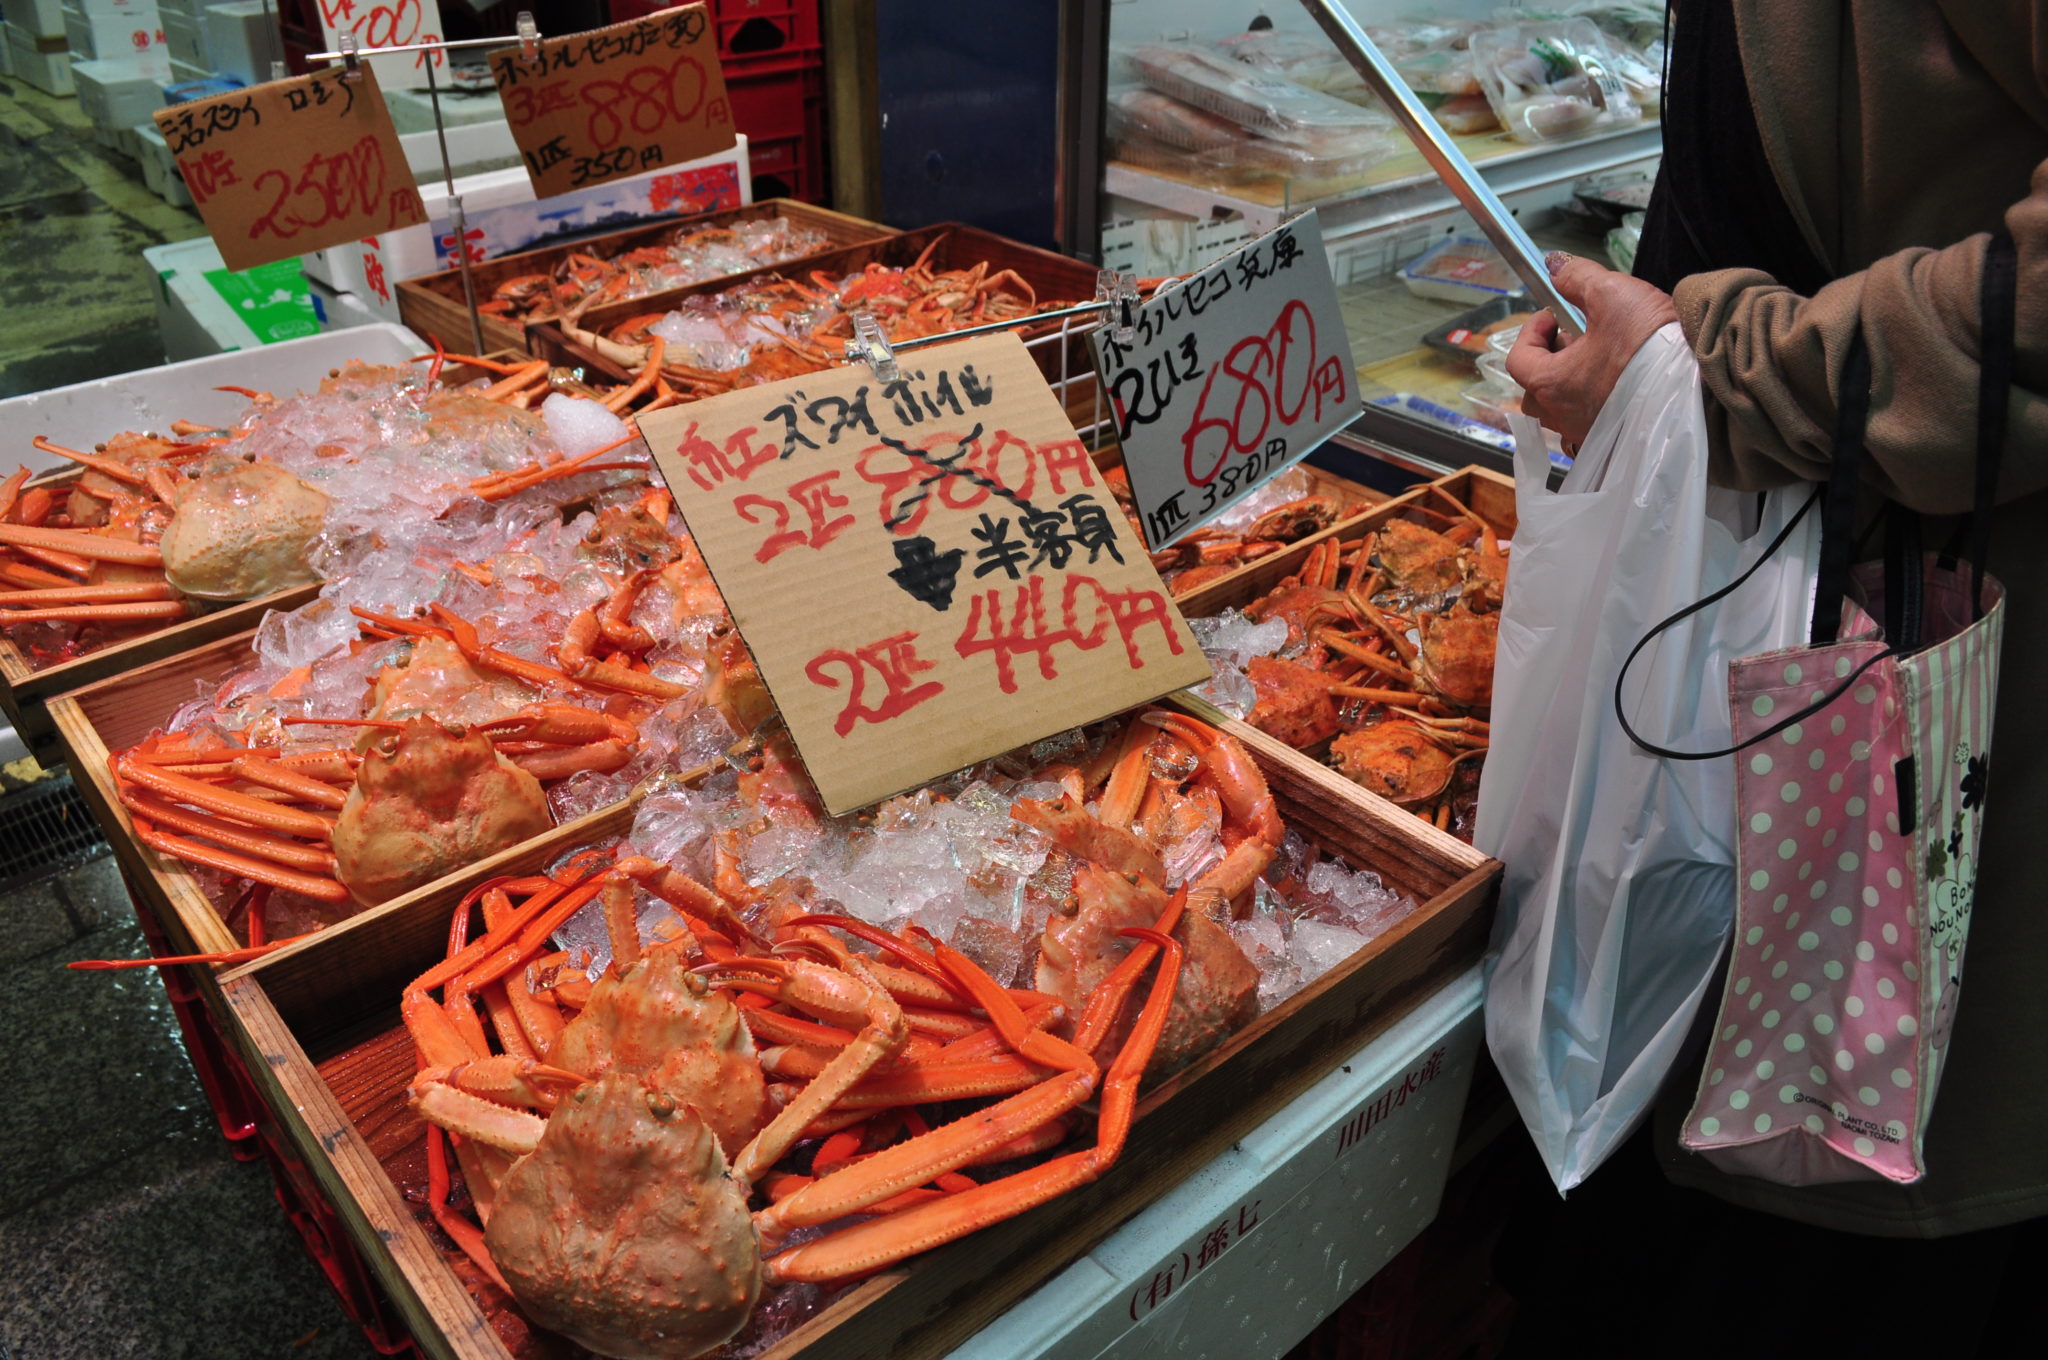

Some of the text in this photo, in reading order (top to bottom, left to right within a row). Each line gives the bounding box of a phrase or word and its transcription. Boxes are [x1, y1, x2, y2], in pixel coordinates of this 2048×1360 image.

[579, 55, 730, 151] 880円
[1181, 299, 1345, 487] 680円
[734, 470, 856, 564] 2匹
[1199, 437, 1288, 515] 380円
[970, 493, 1126, 581] 半額
[805, 573, 1183, 738] 2匹 440円
[1336, 1046, 1447, 1159] 川田水産
